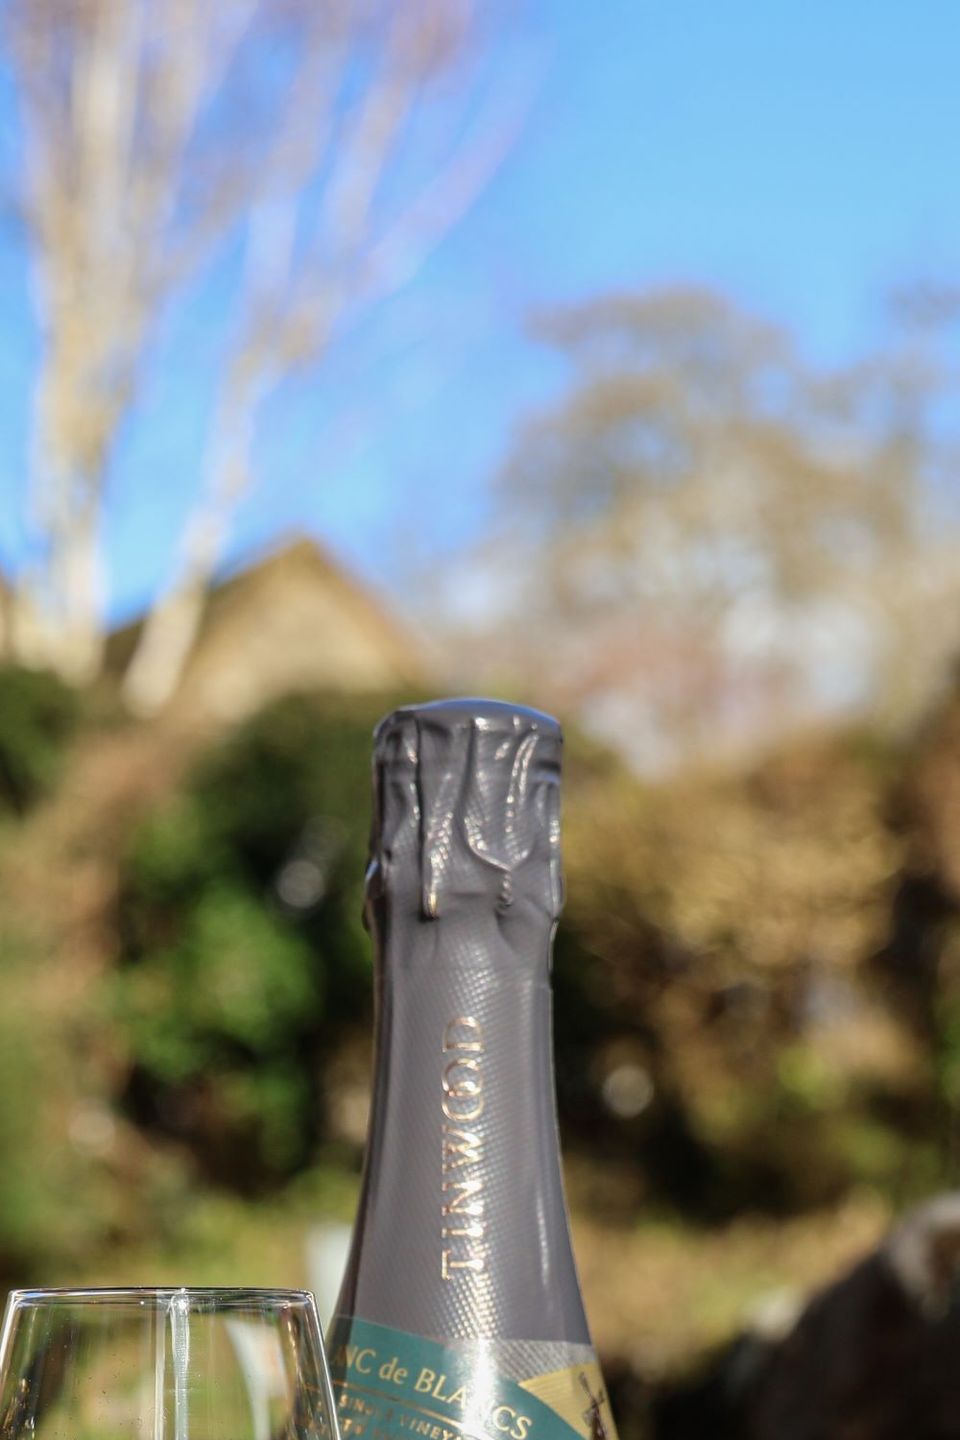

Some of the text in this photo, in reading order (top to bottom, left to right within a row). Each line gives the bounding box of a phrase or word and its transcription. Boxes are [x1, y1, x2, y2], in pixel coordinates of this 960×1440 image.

[442, 1016, 483, 1280] TINWOOD
[339, 1393, 394, 1422] SINE
[378, 1356, 409, 1385] de
[414, 1367, 533, 1440] BLACS
